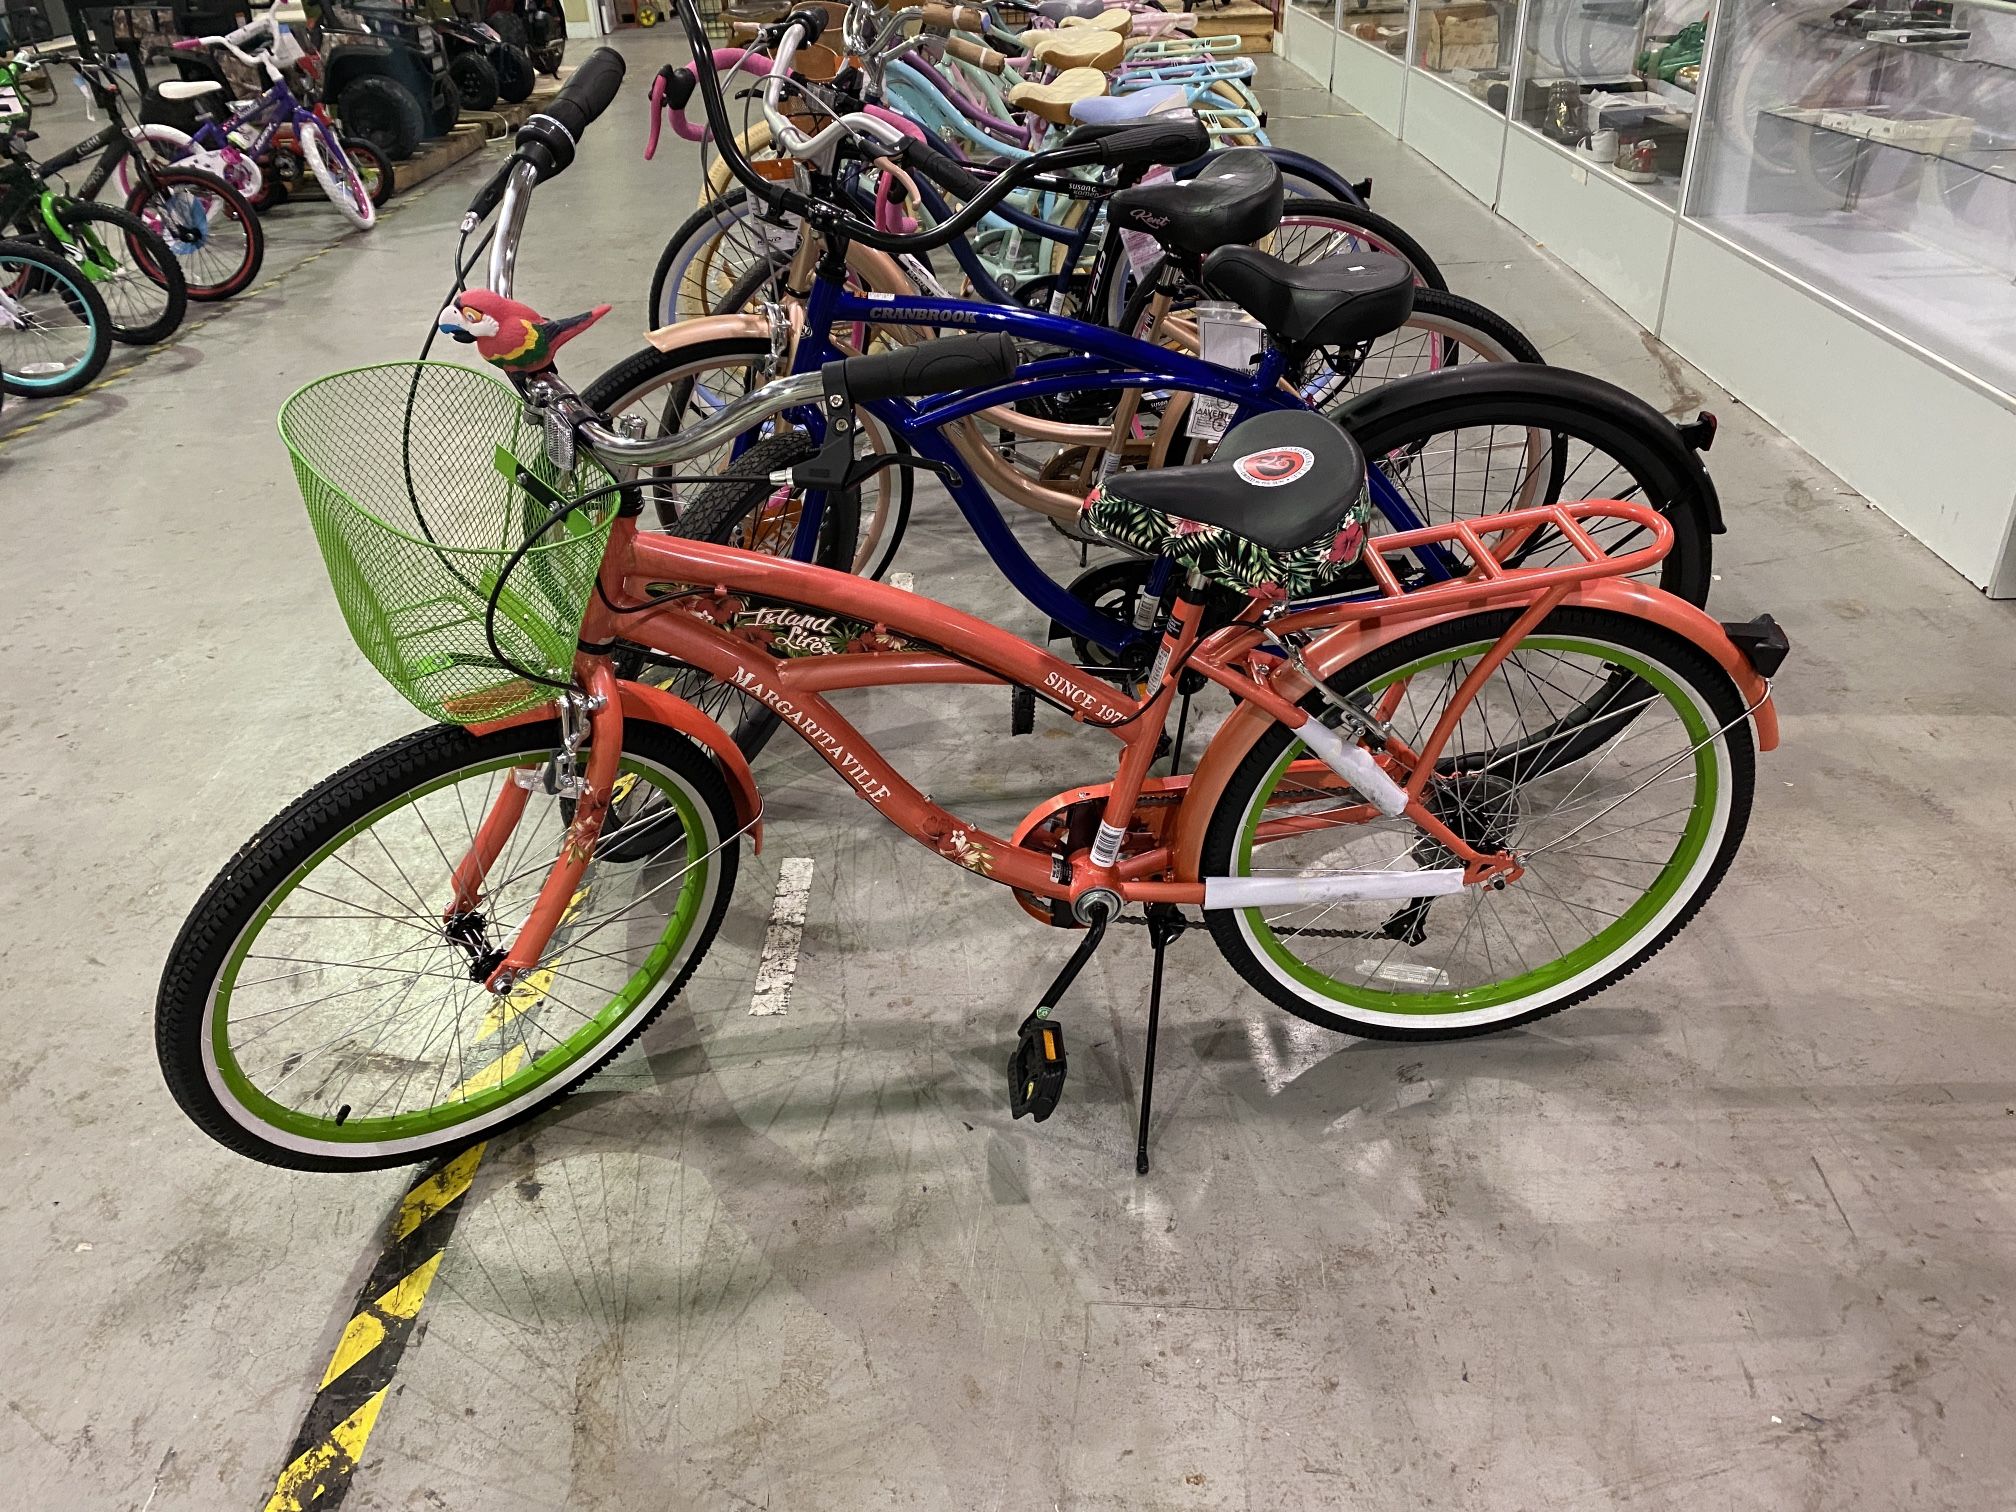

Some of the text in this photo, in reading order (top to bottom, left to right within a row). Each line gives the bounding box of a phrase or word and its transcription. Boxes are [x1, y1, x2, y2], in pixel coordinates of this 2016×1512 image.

[870, 307, 977, 324] CRANBROOK
[739, 607, 837, 634] Island
[1044, 672, 1097, 710] SINCE
[729, 666, 891, 803] MARGARITAVILLE
